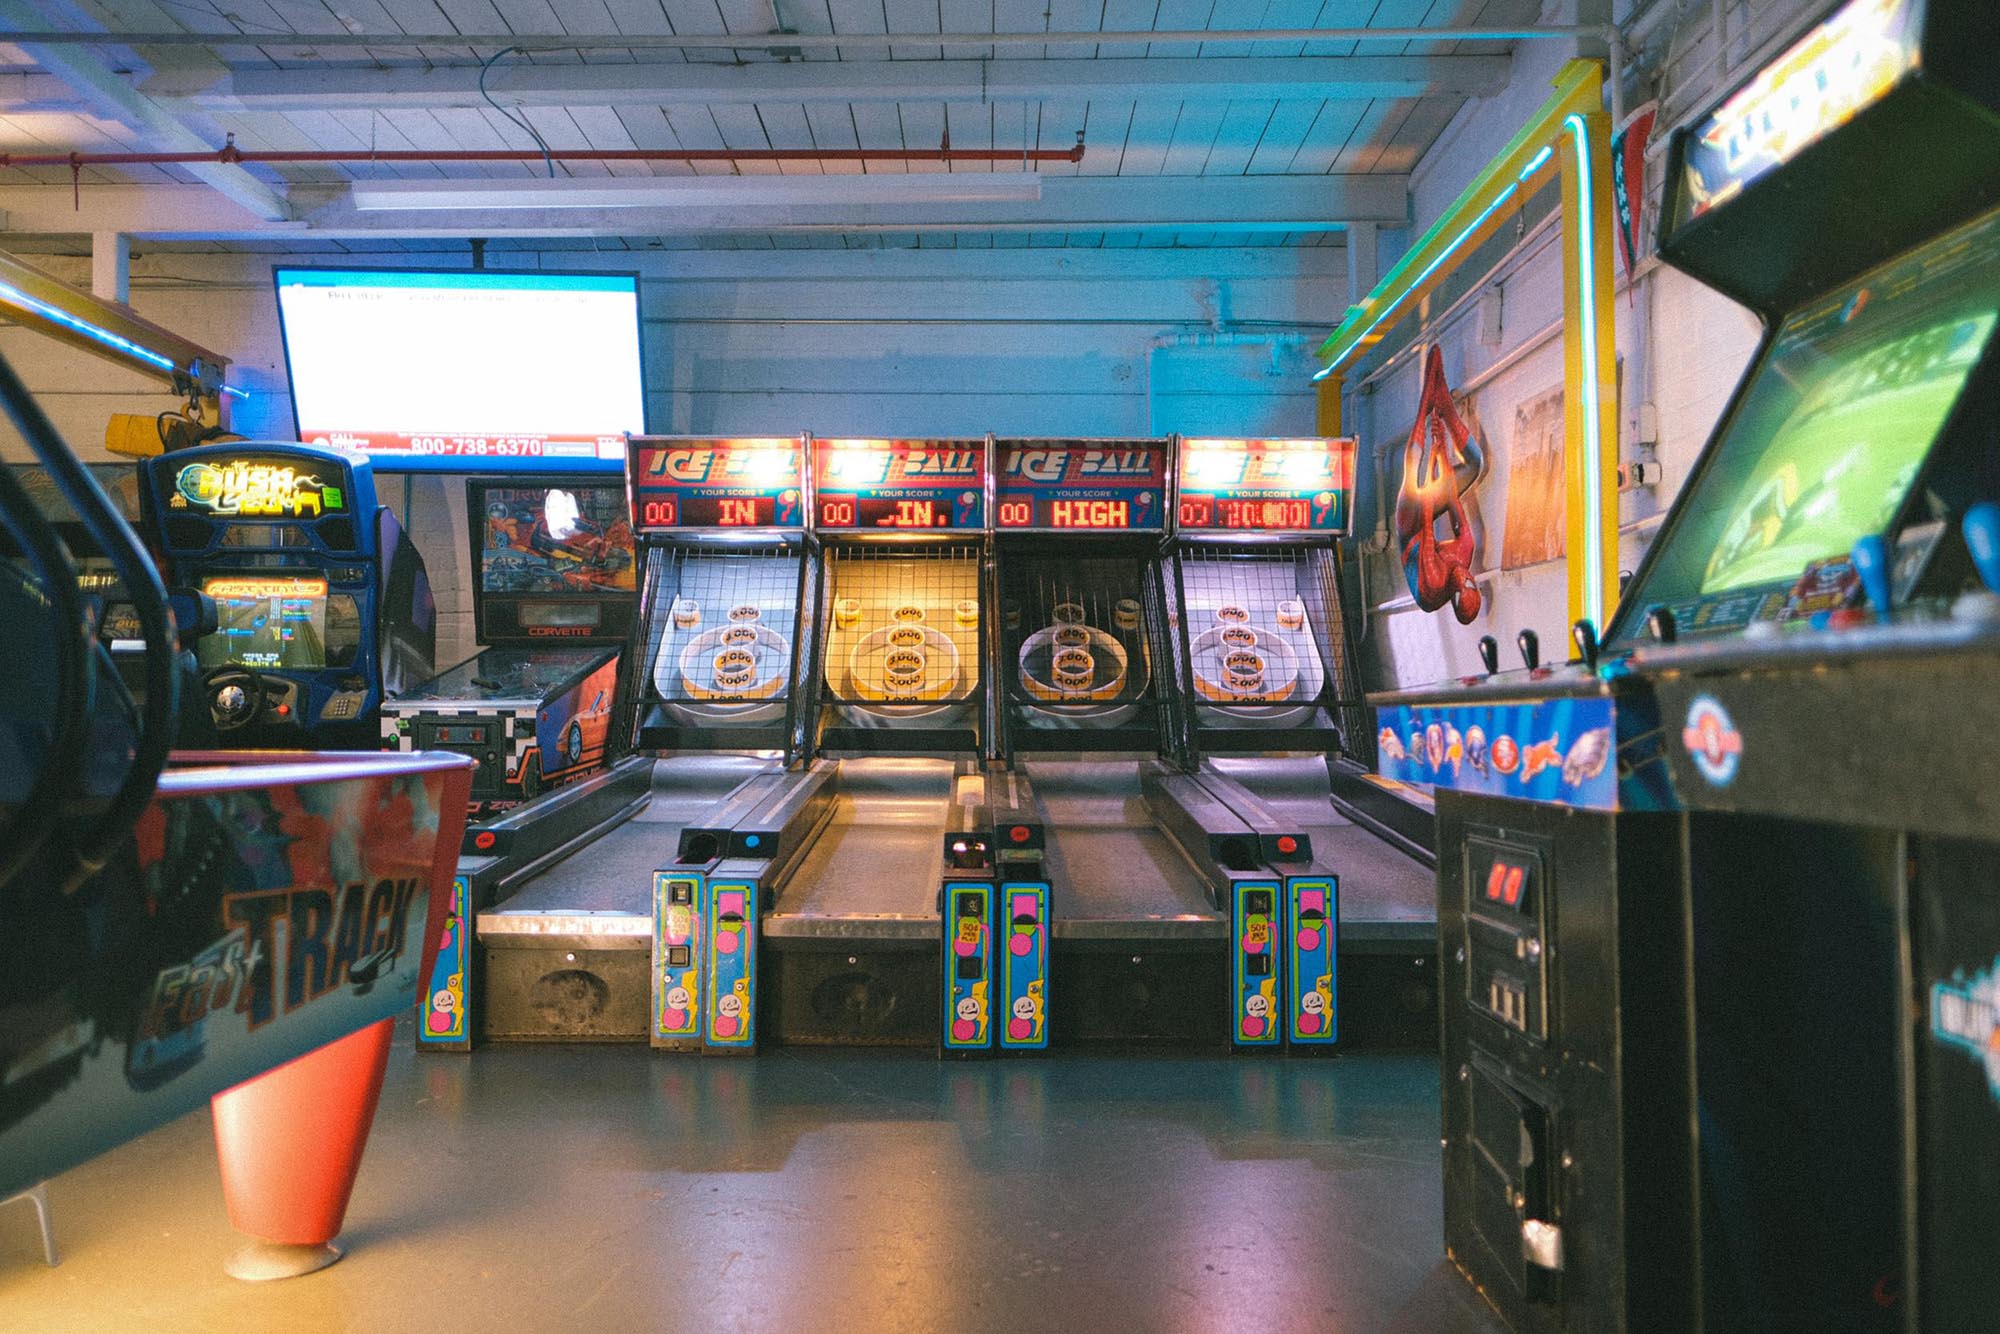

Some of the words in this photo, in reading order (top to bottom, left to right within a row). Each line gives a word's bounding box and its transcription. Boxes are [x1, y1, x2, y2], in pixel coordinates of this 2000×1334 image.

[411, 437, 541, 456] 800-738-6370
[648, 449, 713, 484] ICE
[904, 450, 977, 477] BALL
[1005, 450, 1071, 483] ICE
[1080, 451, 1152, 477] BALL
[700, 489, 726, 497] YOUR
[727, 489, 756, 497] SCORE
[878, 490, 903, 498] YOUR
[905, 490, 935, 498] SCORE
[1056, 490, 1081, 498] YOUR
[1083, 490, 1112, 498] SCORE
[1236, 490, 1260, 498] YOUR
[1262, 490, 1292, 498] SCORE
[644, 501, 674, 525] 00
[719, 500, 756, 526] IN
[823, 502, 852, 525] 00
[999, 502, 1030, 525] 00
[1052, 501, 1129, 528] HIGH
[528, 627, 593, 637] CORVETTE
[222, 874, 421, 1033] TRACK
